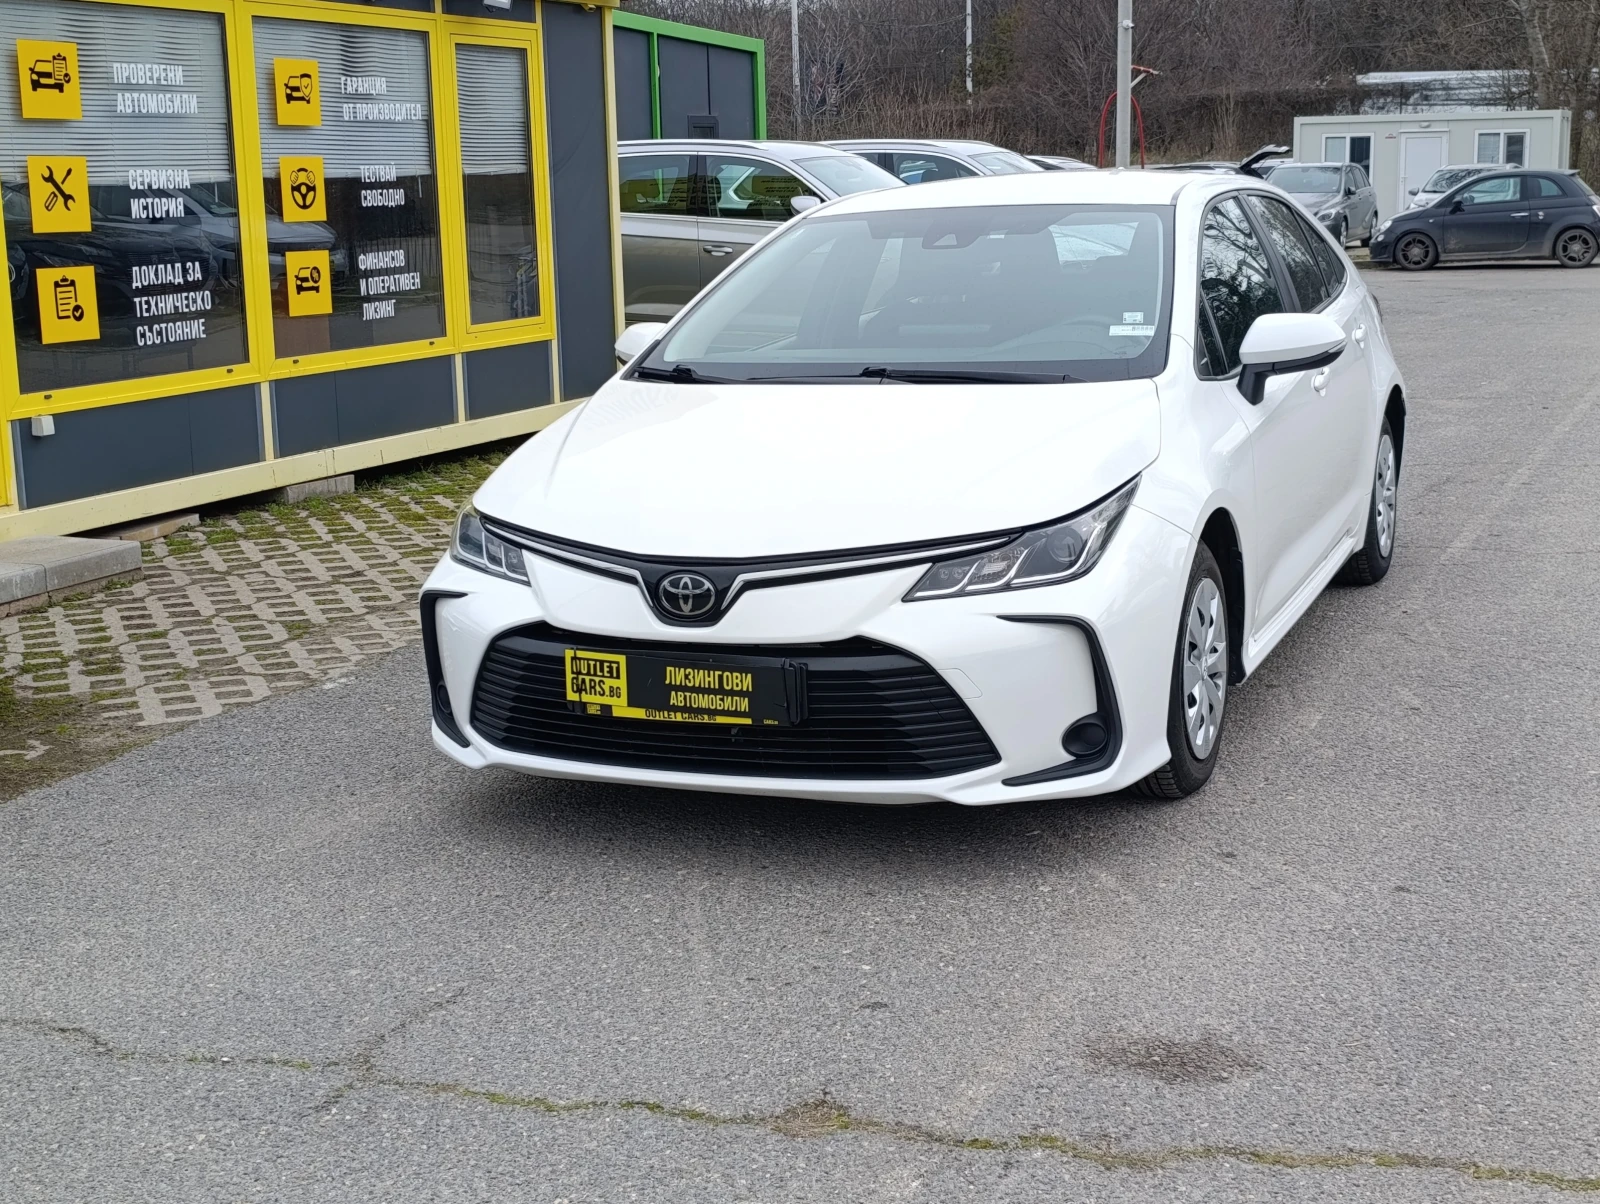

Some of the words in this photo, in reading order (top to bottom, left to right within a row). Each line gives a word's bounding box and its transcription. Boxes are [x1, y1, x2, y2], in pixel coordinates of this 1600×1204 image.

[113, 63, 184, 85] ПРОВЕРЕНИ
[341, 77, 387, 96] ГАРАНЦИЯ
[117, 93, 198, 114] АВТОМОБИЛИ
[343, 104, 354, 120] ОТ
[356, 104, 422, 122] ПРОИЗВОДИТЕЛ
[128, 169, 191, 190] СЕРВИЗНА
[360, 161, 397, 182] ТЕСТВАЙ
[130, 197, 185, 219] ИСТОРИЯ
[361, 188, 405, 207] СВОБОДНО
[358, 249, 405, 270] ФИНАНСОВ
[132, 263, 184, 289] ДОКЛАД
[186, 261, 203, 281] ЗА
[360, 279, 367, 296] И
[368, 272, 421, 295] ОПЕРАТИВЕН
[134, 290, 212, 317] ТЕХНИЧЕСКО
[363, 299, 396, 321] ЛИЗИНГ
[136, 319, 207, 347] СЪСТОЯНИЕ
[572, 659, 618, 677] OUTLET
[571, 676, 621, 699] CARS.BG
[665, 666, 753, 692] ЛИЗИНГОВИ
[670, 691, 749, 712] АВТОМОБИЛИ
